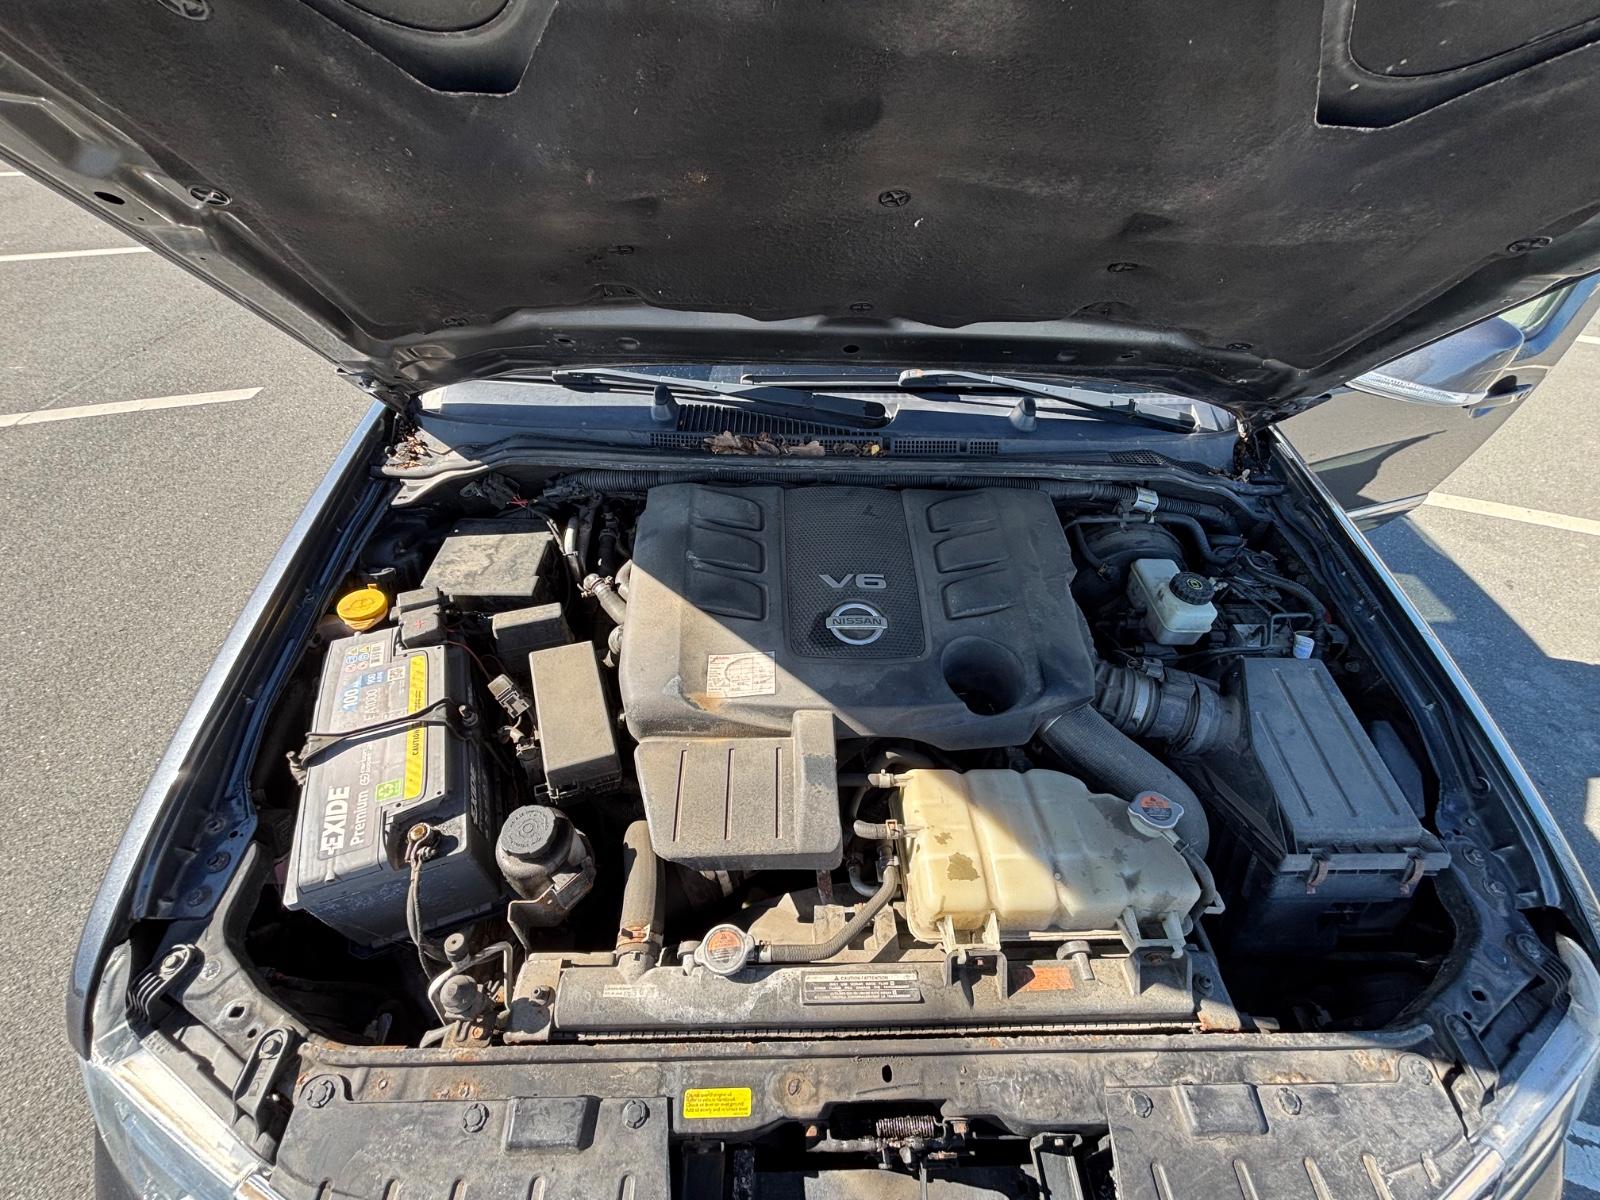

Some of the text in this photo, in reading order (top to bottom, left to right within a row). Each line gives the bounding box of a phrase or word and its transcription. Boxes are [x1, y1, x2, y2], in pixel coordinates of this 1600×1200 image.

[819, 574, 886, 588] V6
[832, 617, 881, 625] NISSAN
[343, 688, 359, 709] 100
[320, 786, 350, 855] EXIDE
[350, 791, 369, 846] Premium
